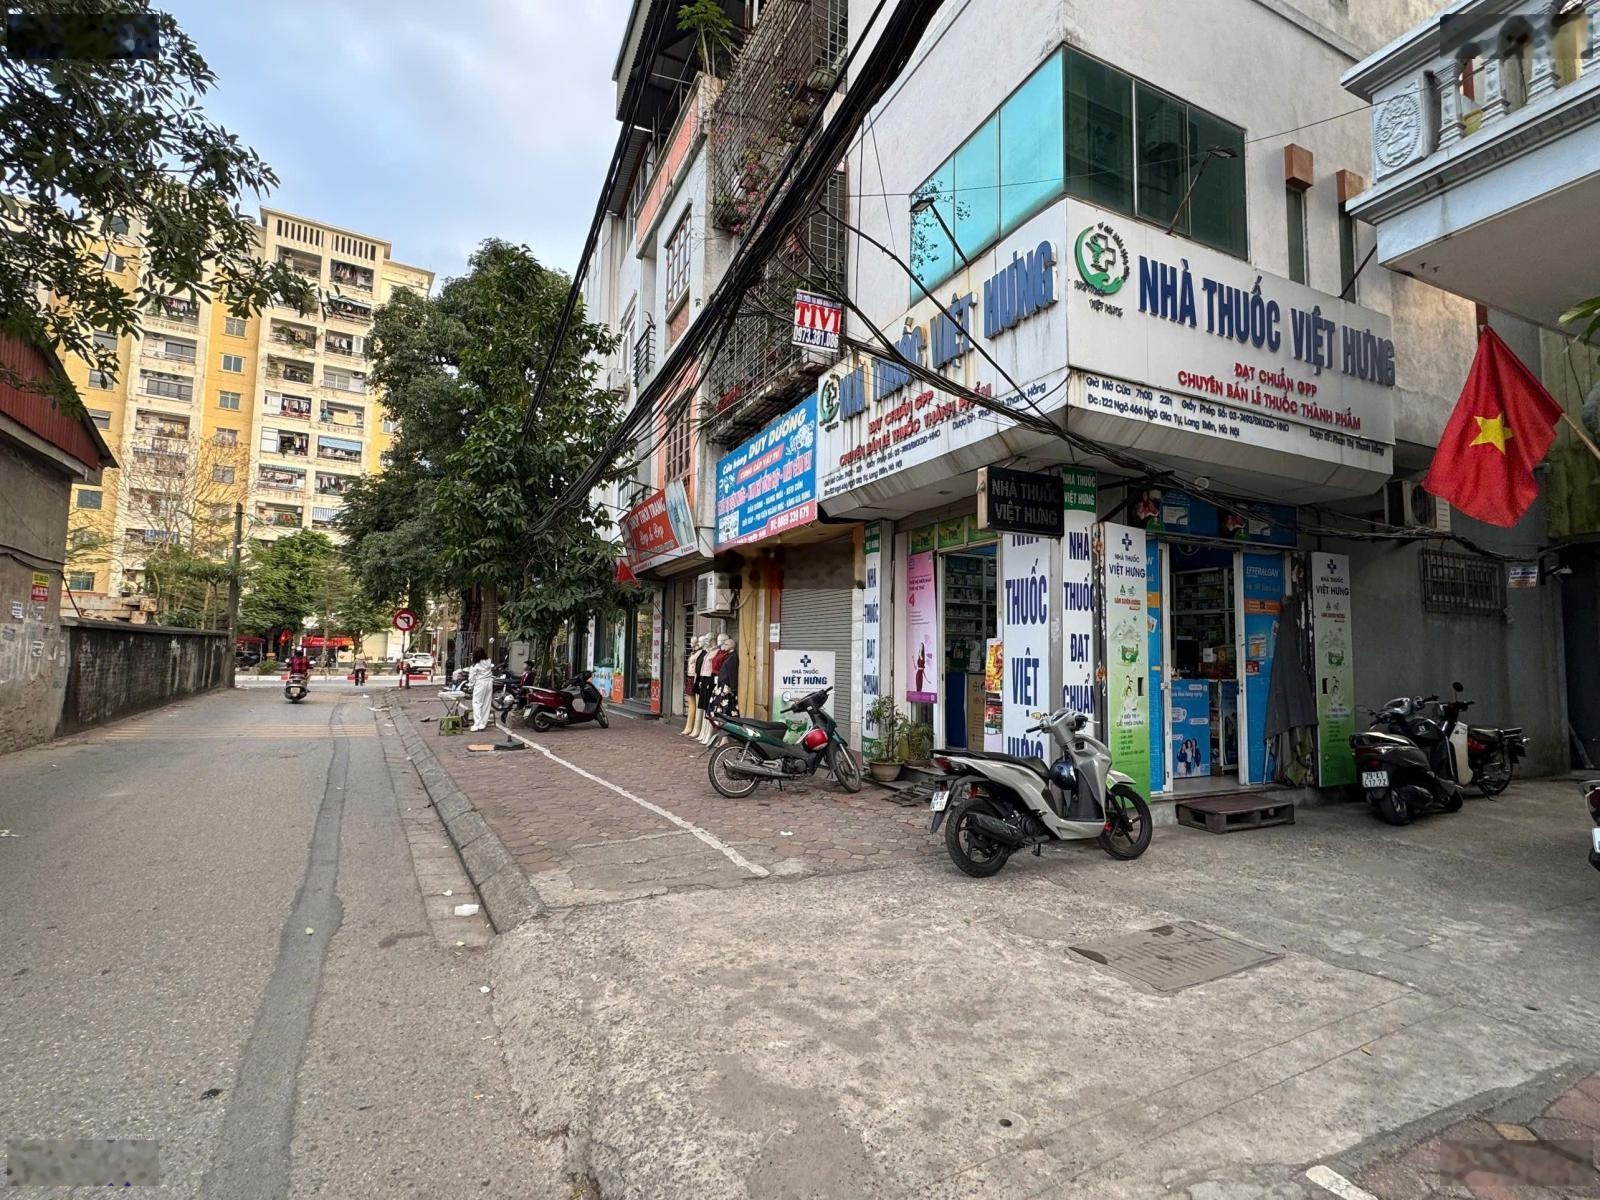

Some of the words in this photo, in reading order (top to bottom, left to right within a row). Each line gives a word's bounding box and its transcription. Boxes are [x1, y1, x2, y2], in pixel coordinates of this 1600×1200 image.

[795, 302, 841, 333] TIVI
[930, 293, 976, 369] VIỆT
[984, 241, 1057, 340] HƯNG
[1138, 256, 1197, 327] NHÀ
[1202, 275, 1281, 351] THUỐC
[1290, 306, 1336, 375] VIỆT
[1341, 325, 1395, 387] HƯNG
[1102, 380, 1113, 391] Mở
[1115, 384, 1131, 396] Cửa
[1135, 388, 1153, 401] 7h00
[1234, 363, 1255, 382] ĐẠT
[1259, 367, 1294, 393] CHUẨN
[1297, 382, 1318, 398] GPP
[914, 390, 934, 410] GPP
[1177, 370, 1223, 396] CHUYÊN
[1227, 381, 1249, 400] BÁN
[1252, 385, 1262, 405] LẺ
[1263, 391, 1298, 414] THUỐC
[1301, 402, 1336, 422] THÀNH
[1335, 407, 1361, 430] PHẨM
[748, 434, 767, 460] DUY
[768, 407, 806, 447] DƯƠNG
[992, 477, 1018, 498] NHÀ
[1020, 481, 1060, 503] THUỐC
[1077, 472, 1096, 488] THUỐC
[995, 500, 1021, 524] VIỆT
[1024, 507, 1058, 526] HƯNG
[1064, 490, 1076, 506] VIỆT
[1078, 494, 1095, 506] HƯNG
[1069, 526, 1090, 561] NHÀ
[1109, 562, 1124, 578] VIỆT
[1125, 565, 1146, 579] HƯNG
[1247, 566, 1279, 577] EFFERALGAN
[909, 591, 915, 607] 4
[1005, 558, 1047, 626] THUỐC
[1063, 573, 1095, 613] THUỐC
[1316, 583, 1329, 597] VIỆT
[1330, 586, 1350, 597] HƯNG
[1070, 634, 1090, 669] ĐẠT
[783, 674, 801, 687] VIỆT
[804, 676, 828, 685] HƯNG
[1011, 647, 1040, 717] VIỆT
[1063, 673, 1096, 714] CHUẨN
